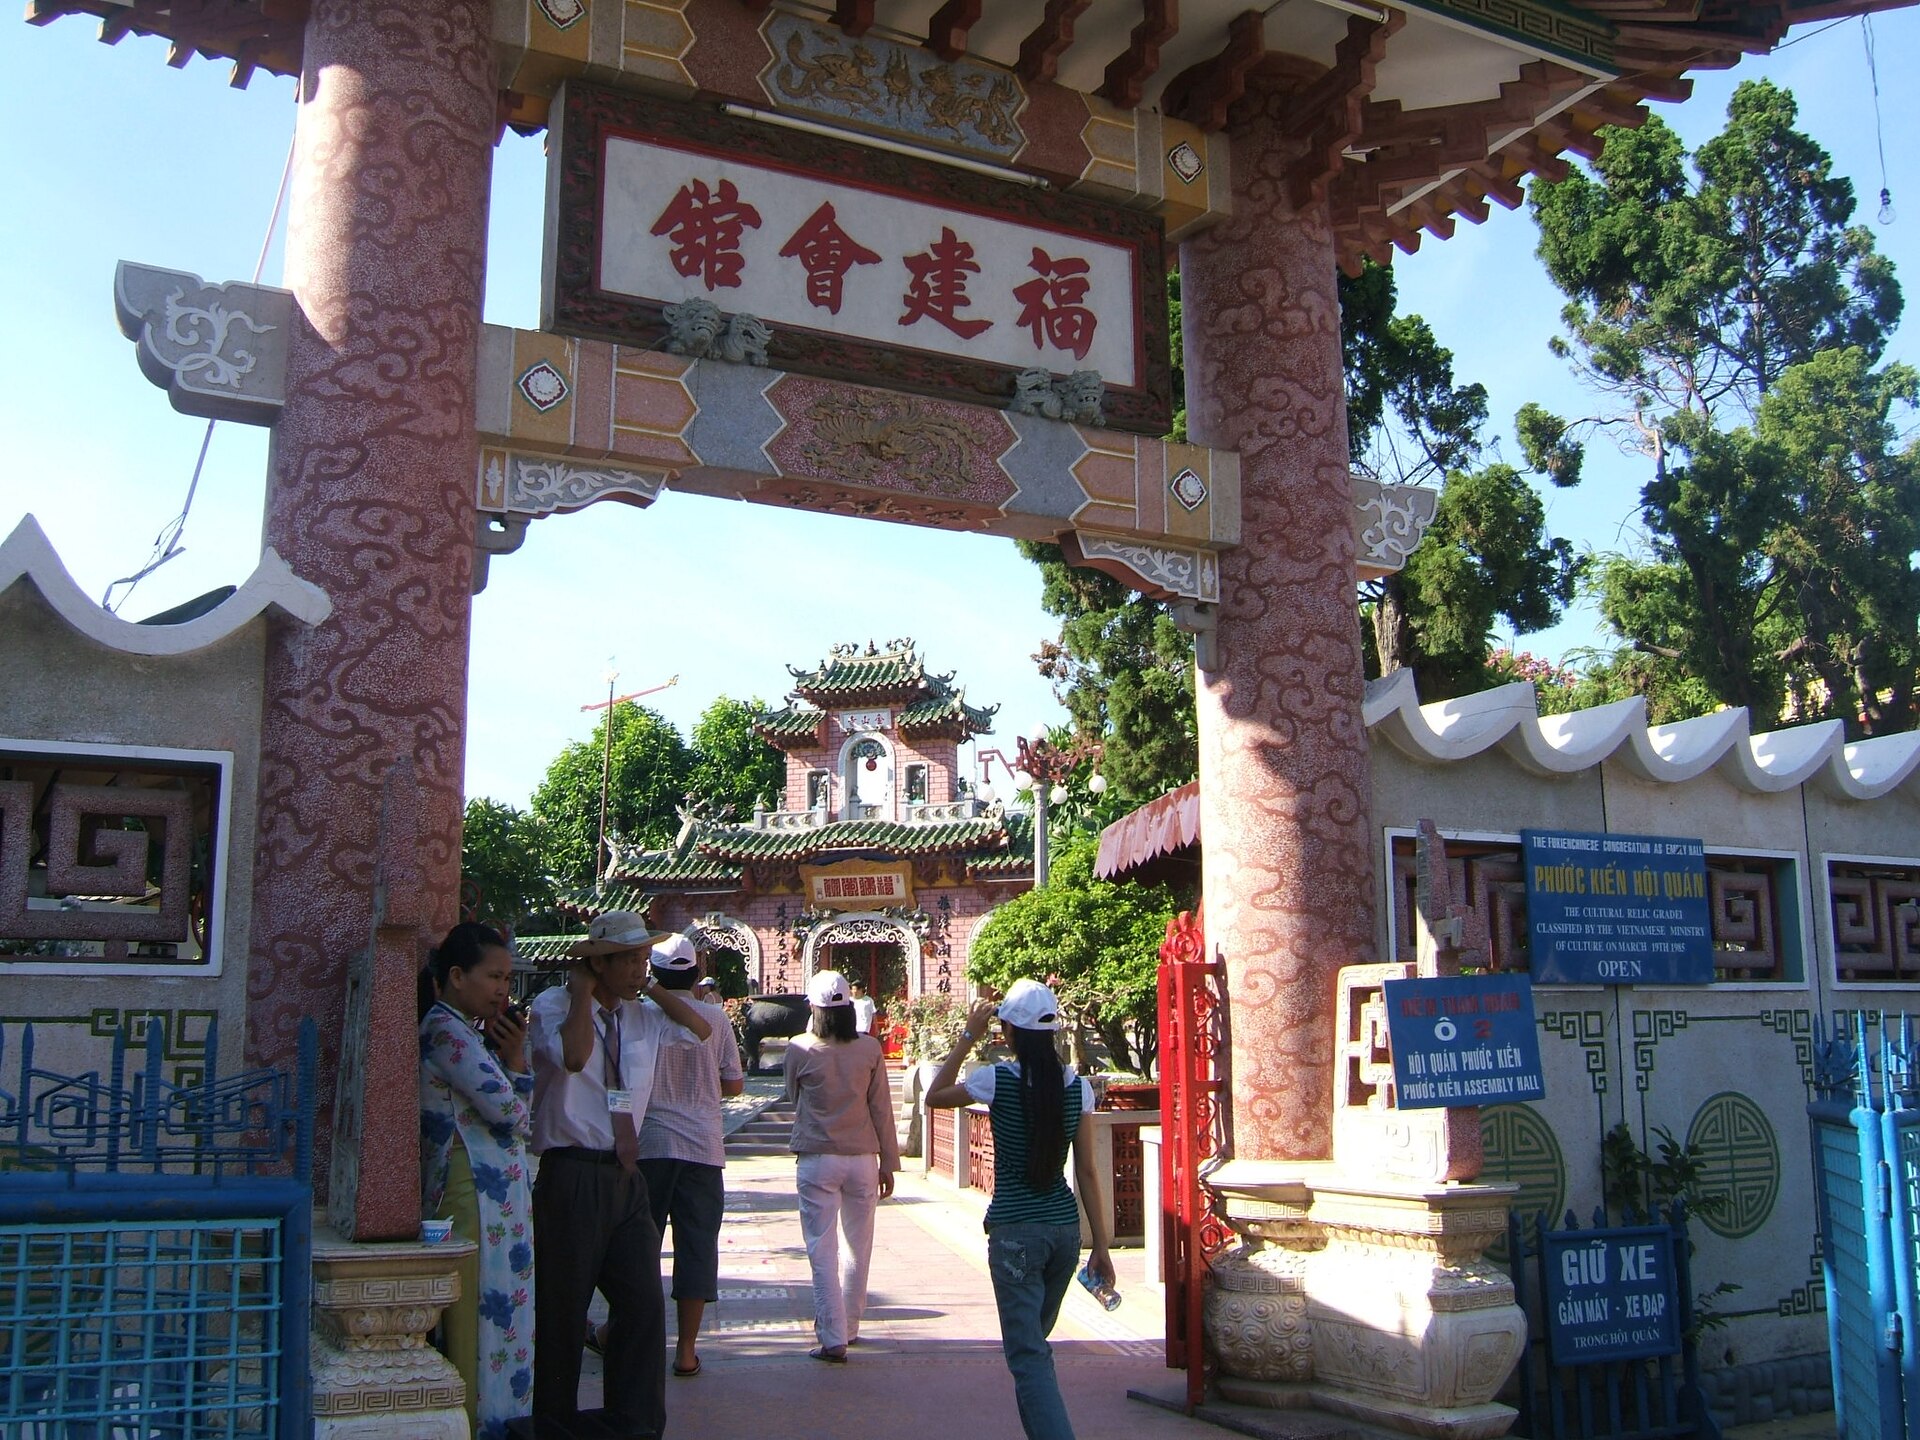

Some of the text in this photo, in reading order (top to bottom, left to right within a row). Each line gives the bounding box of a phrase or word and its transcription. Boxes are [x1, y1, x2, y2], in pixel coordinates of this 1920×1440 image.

[1534, 857, 1704, 902] PHƯỚC KIẾN HỘI QUÁN
[1564, 906, 1580, 917] THE
[1583, 907, 1624, 919] CULTURAL
[1627, 908, 1650, 919] RELIC
[1536, 923, 1705, 937] CLASSIFIED BY THE VIETNAMESE MINISTRY
[1555, 940, 1566, 951] OF
[1568, 941, 1603, 952] CULTURE
[1605, 941, 1617, 952] ON
[1618, 942, 1647, 953] MARCH
[1652, 942, 1669, 953] 19TH
[1597, 960, 1642, 977] OPEN
[1434, 1016, 1494, 1041] Ô 2
[1407, 1042, 1522, 1078] HỘI QUÁN PHƯỚC KIẾN
[1403, 1074, 1540, 1100] PHƯỚC KIẾN ASSEMBLY HALL
[1561, 1239, 1656, 1286] GIỮ XE
[1558, 1290, 1583, 1325] GẮN
[1585, 1292, 1609, 1322] MÁY
[1625, 1295, 1641, 1318] XE
[1642, 1293, 1665, 1323] ĐẠP
[1573, 1326, 1661, 1349] TRONG HỘI QUÁN
